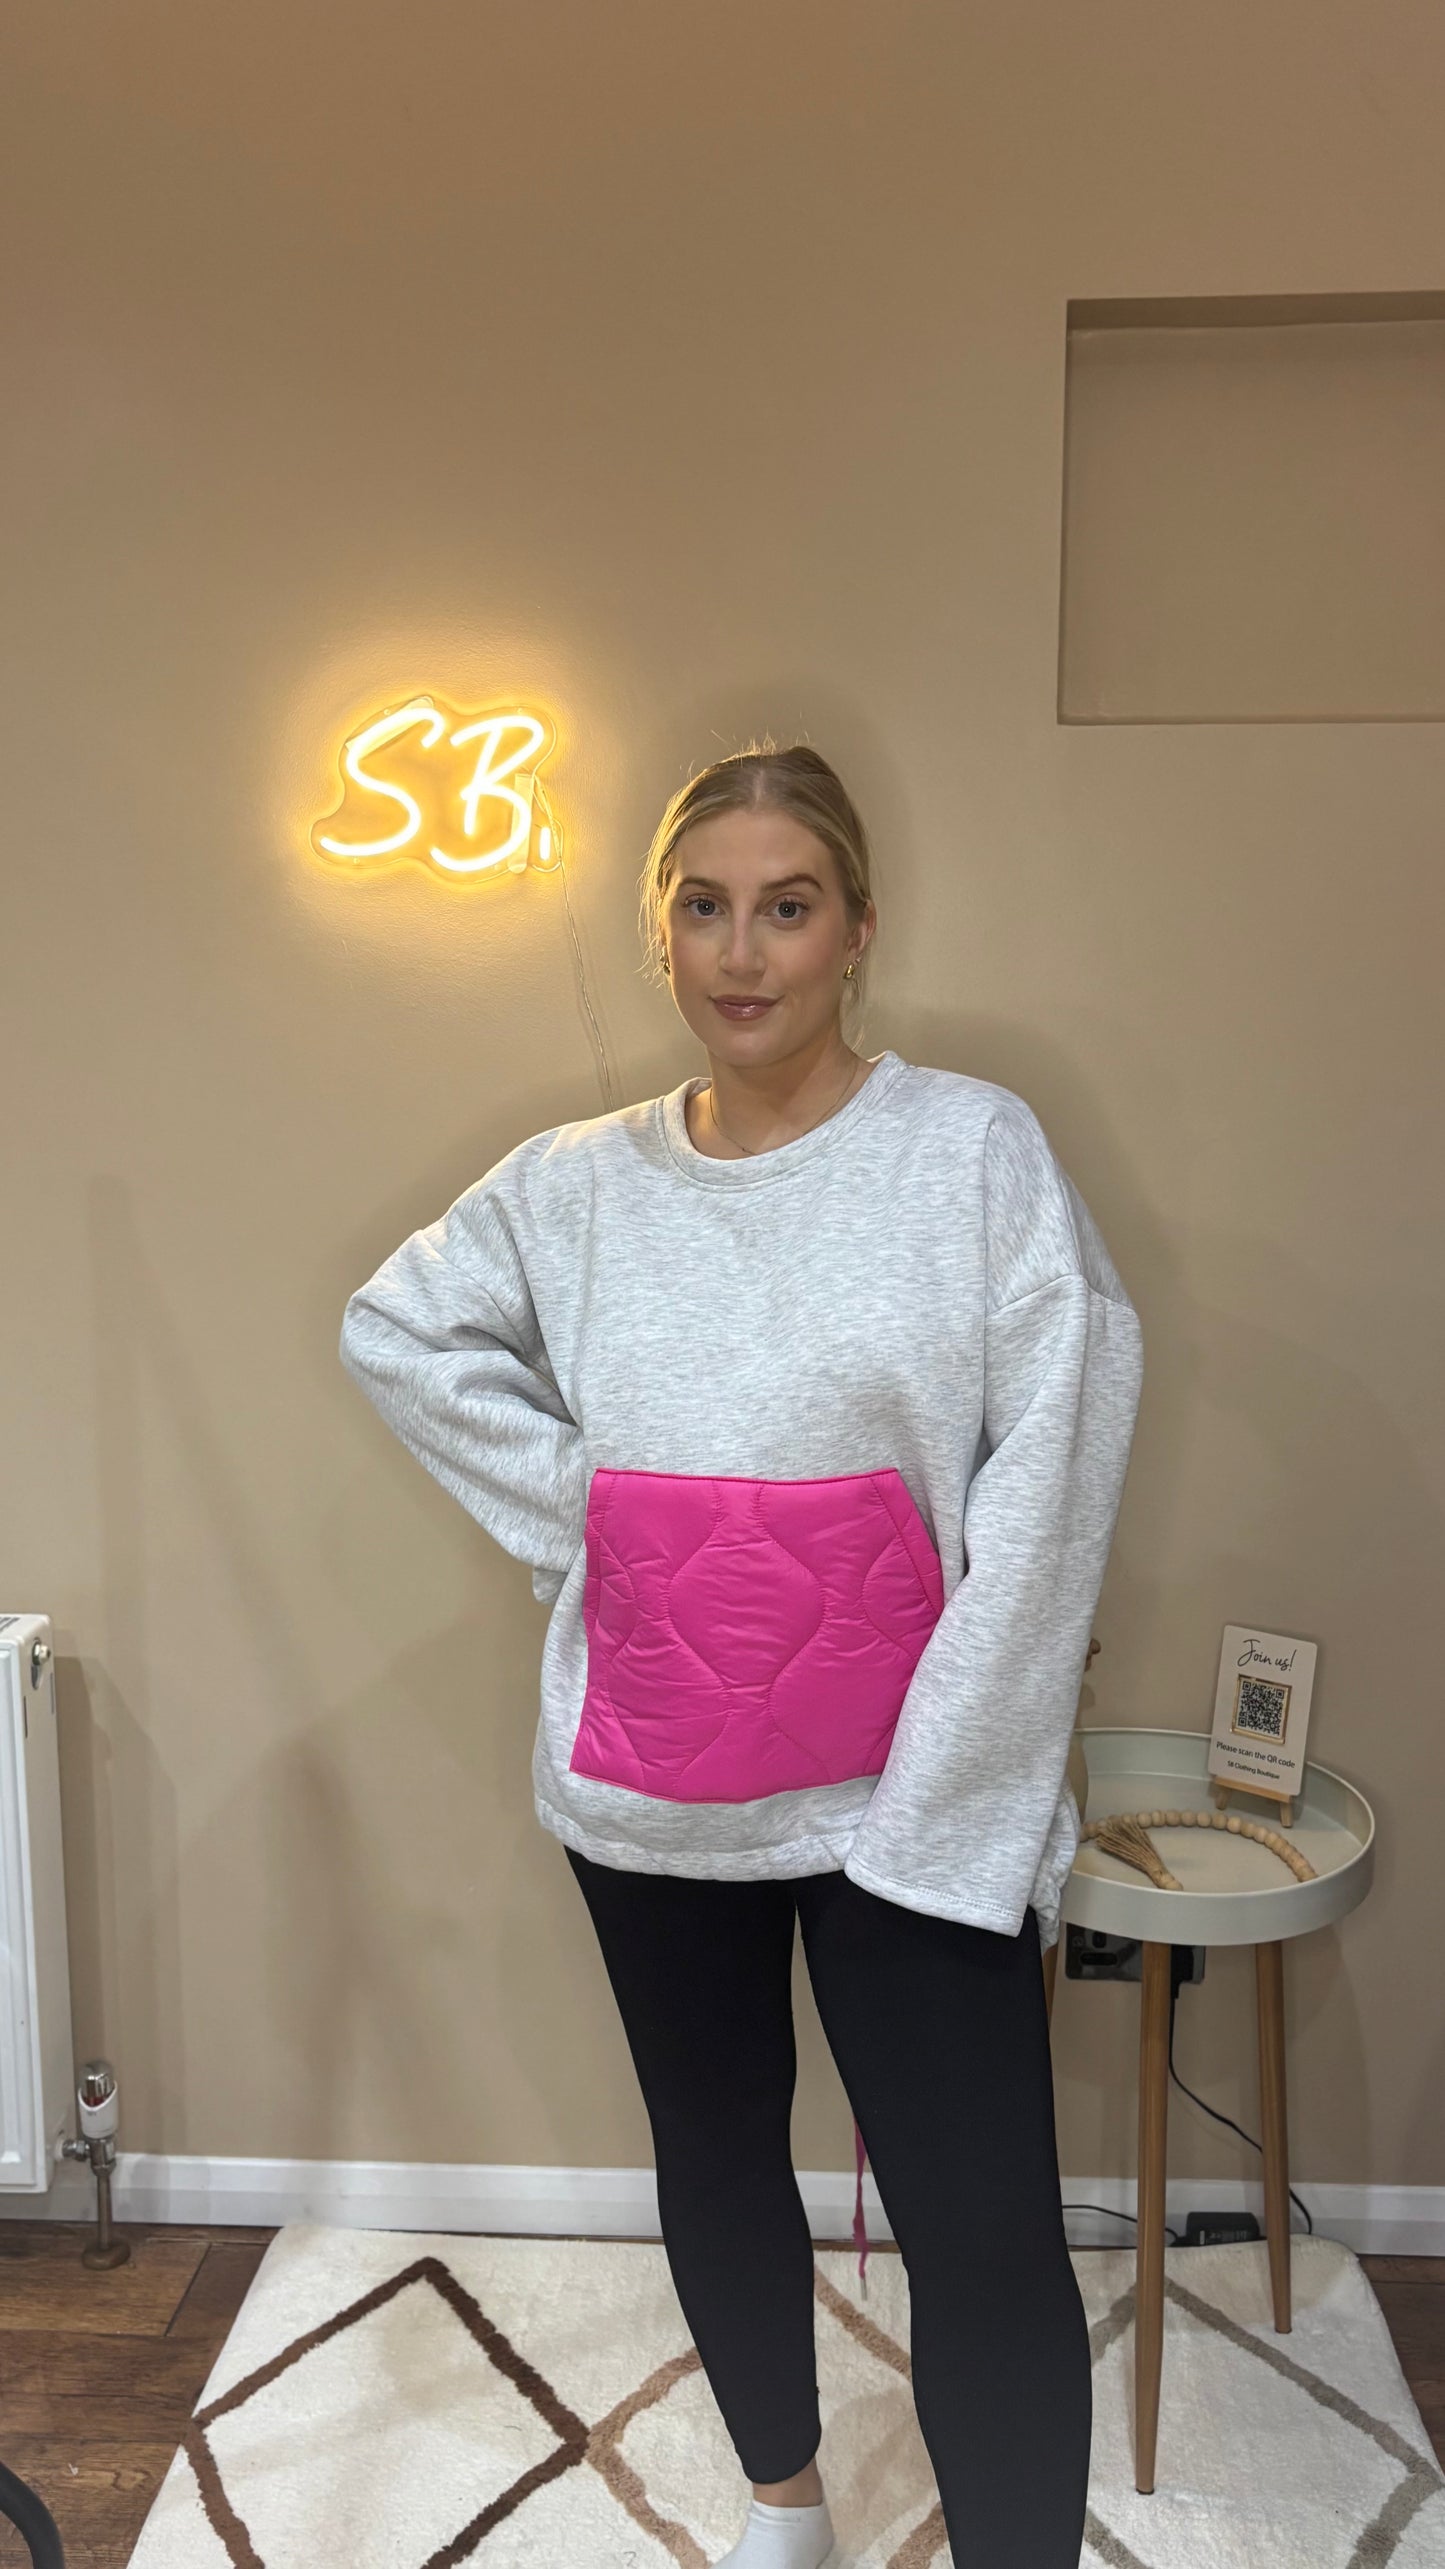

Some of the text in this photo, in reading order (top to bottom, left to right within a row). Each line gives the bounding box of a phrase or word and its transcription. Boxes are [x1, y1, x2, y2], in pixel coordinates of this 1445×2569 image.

[1237, 1638, 1297, 1671] Join us!
[1216, 1741, 1295, 1768] Please scan the QR code
[1234, 1762, 1256, 1774] Clothing
[1257, 1768, 1280, 1780] Boutique
